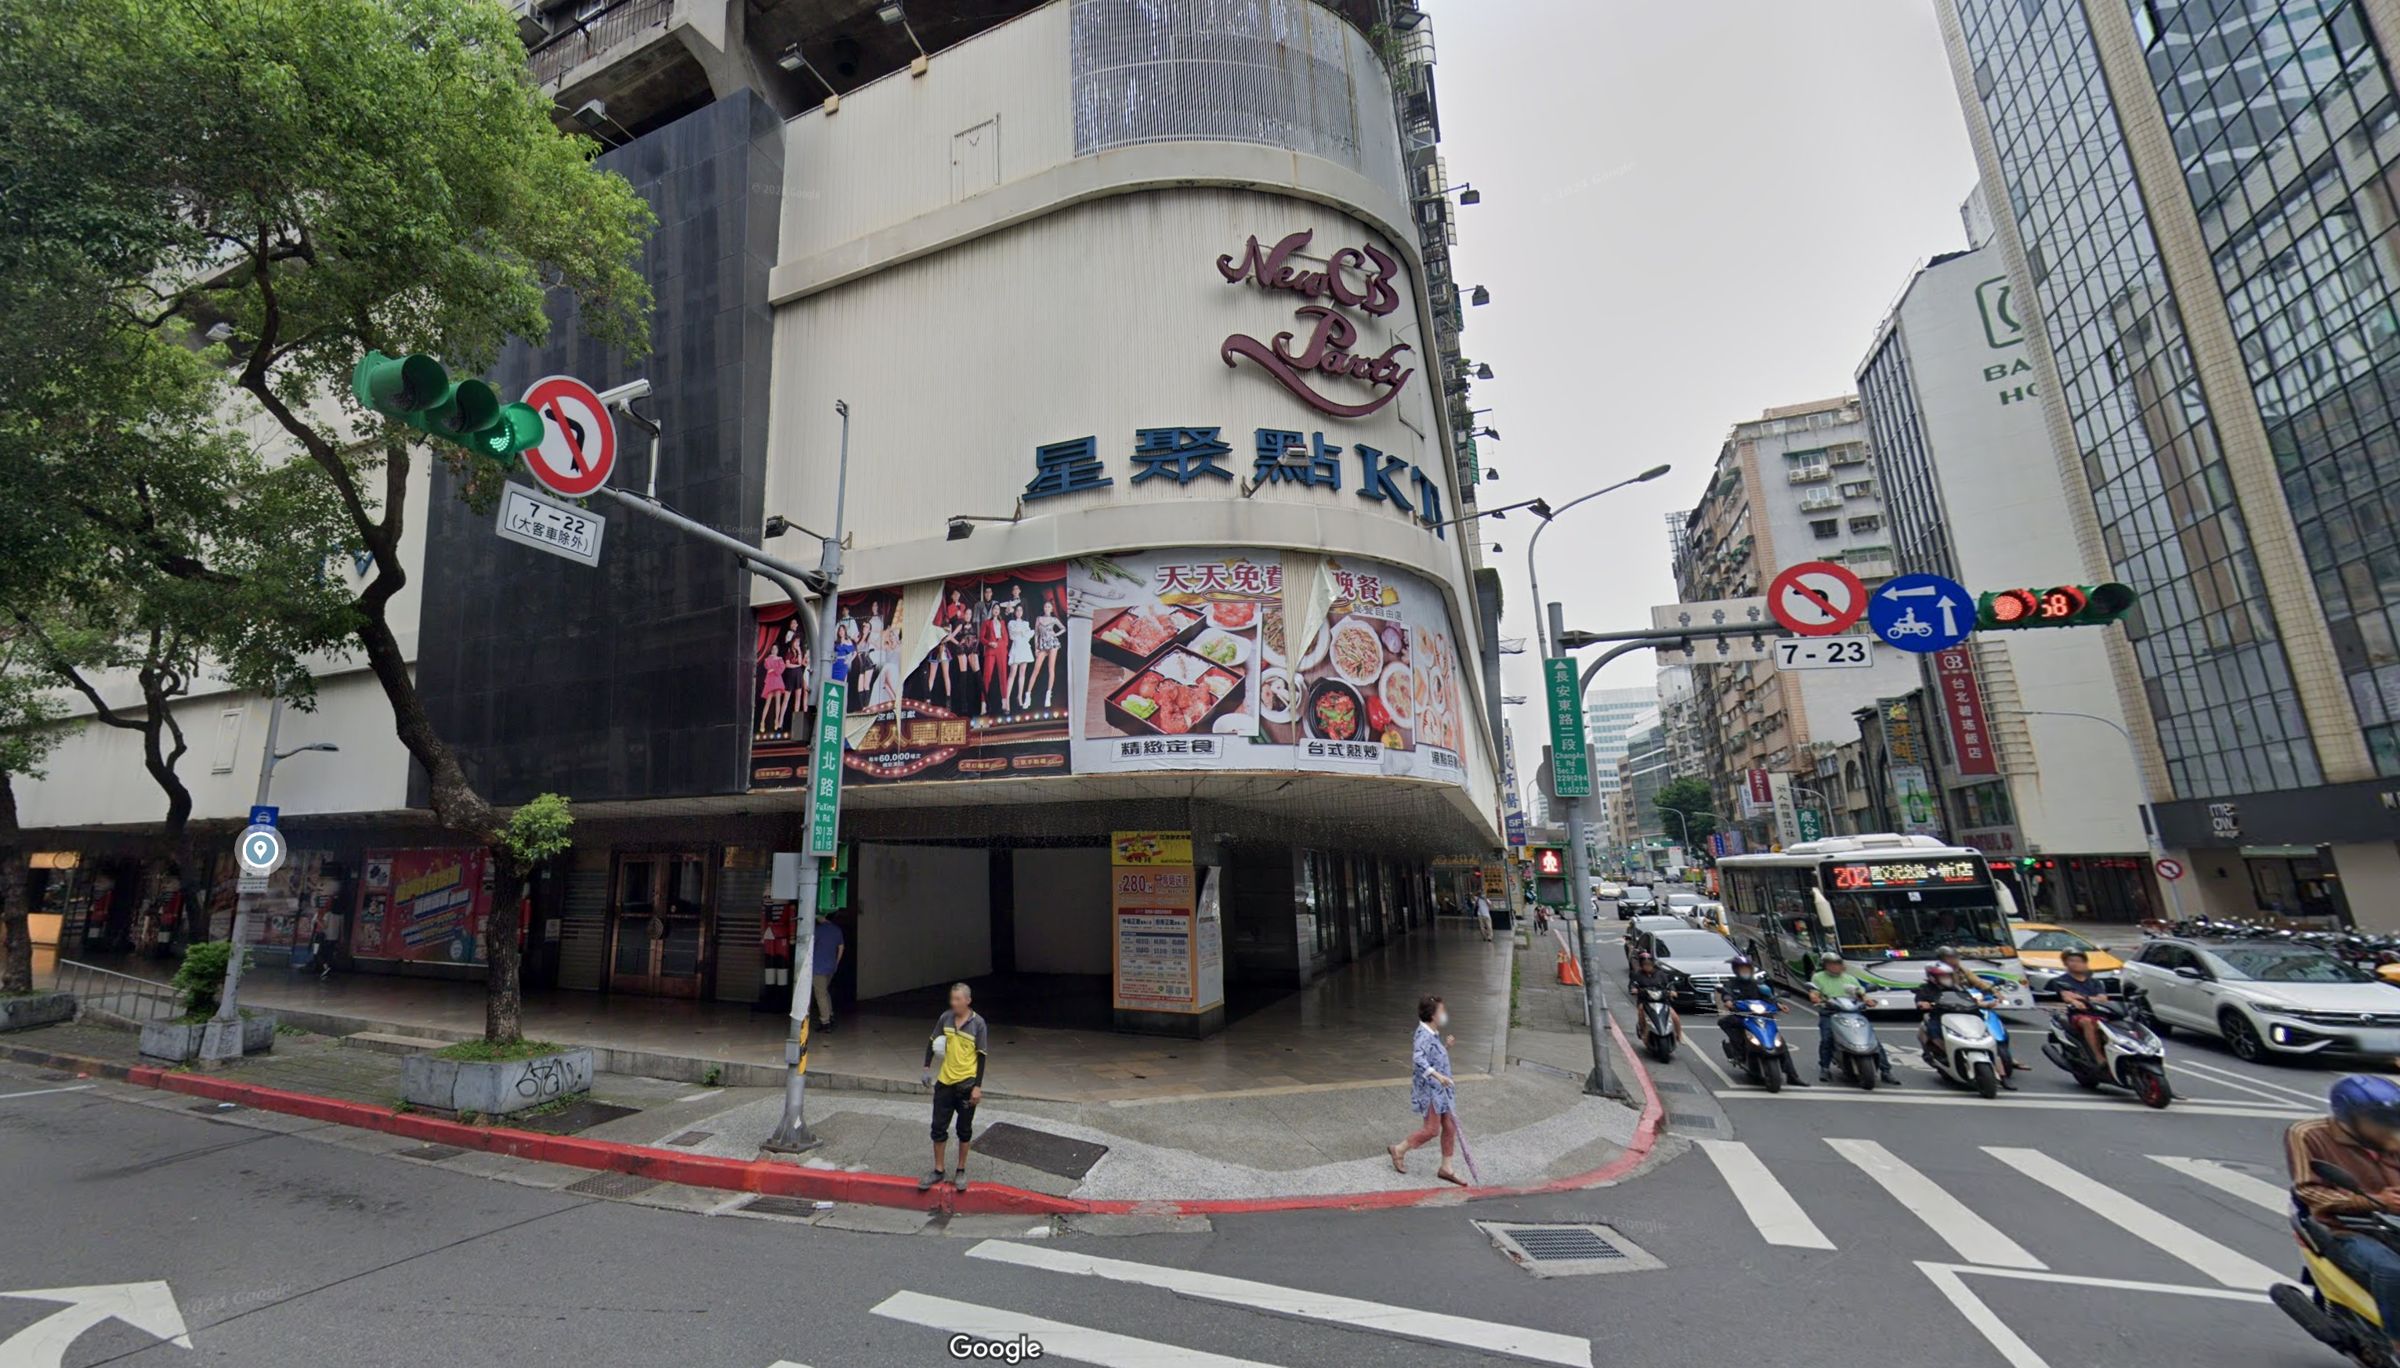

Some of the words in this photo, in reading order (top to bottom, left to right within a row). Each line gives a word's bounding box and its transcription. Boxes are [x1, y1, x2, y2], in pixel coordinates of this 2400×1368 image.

[1216, 228, 1330, 297] New
[1328, 243, 1400, 317] CB
[1221, 306, 1414, 418] Party
[819, 699, 839, 798] 復興北路
[1121, 738, 1215, 756] 精緻定食
[1308, 741, 1380, 761] 台式熱炒
[1554, 671, 1577, 751] 長安東路二段
[1951, 678, 1983, 760] 台北碧瑤飯店
[1833, 865, 1872, 888] 202
